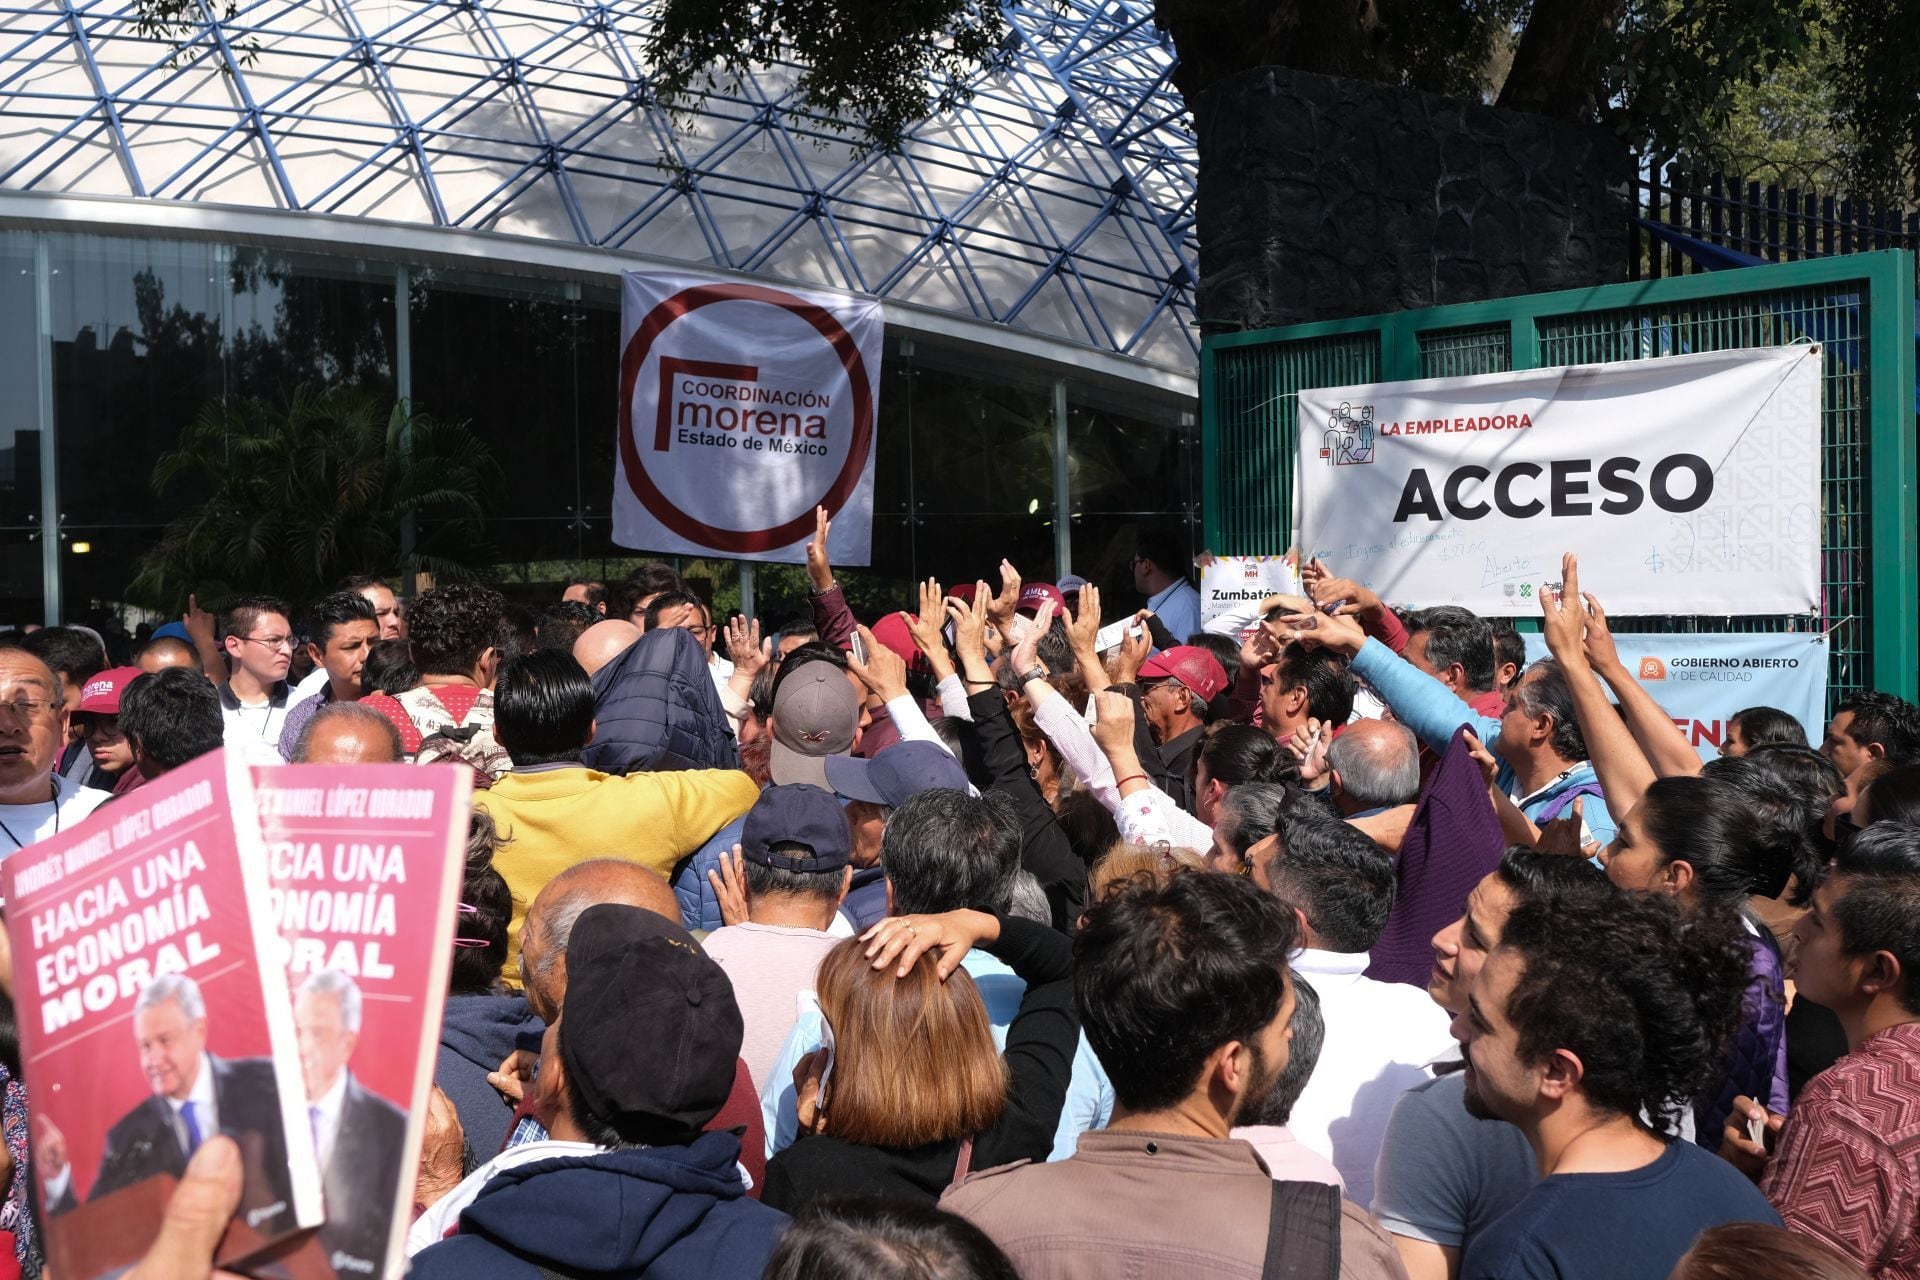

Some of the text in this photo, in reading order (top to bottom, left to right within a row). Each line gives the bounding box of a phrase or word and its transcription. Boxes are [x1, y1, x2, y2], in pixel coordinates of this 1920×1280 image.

[682, 380, 830, 409] COORDINACIÓN
[678, 401, 826, 439] morena
[1380, 414, 1532, 437] LA EMPLEADORA
[678, 429, 828, 456] Estado de México
[1393, 453, 1714, 523] ACCESO
[1244, 570, 1258, 578] MH
[1670, 671, 1753, 682] Y DE CALIDAD
[1671, 657, 1799, 669] GOBIERNO ABIERTO
[332, 843, 406, 884] UNA
[31, 840, 206, 949] HACIA UNA
[36, 882, 211, 996] ECONOMÍA
[41, 932, 221, 1035] MORAL
